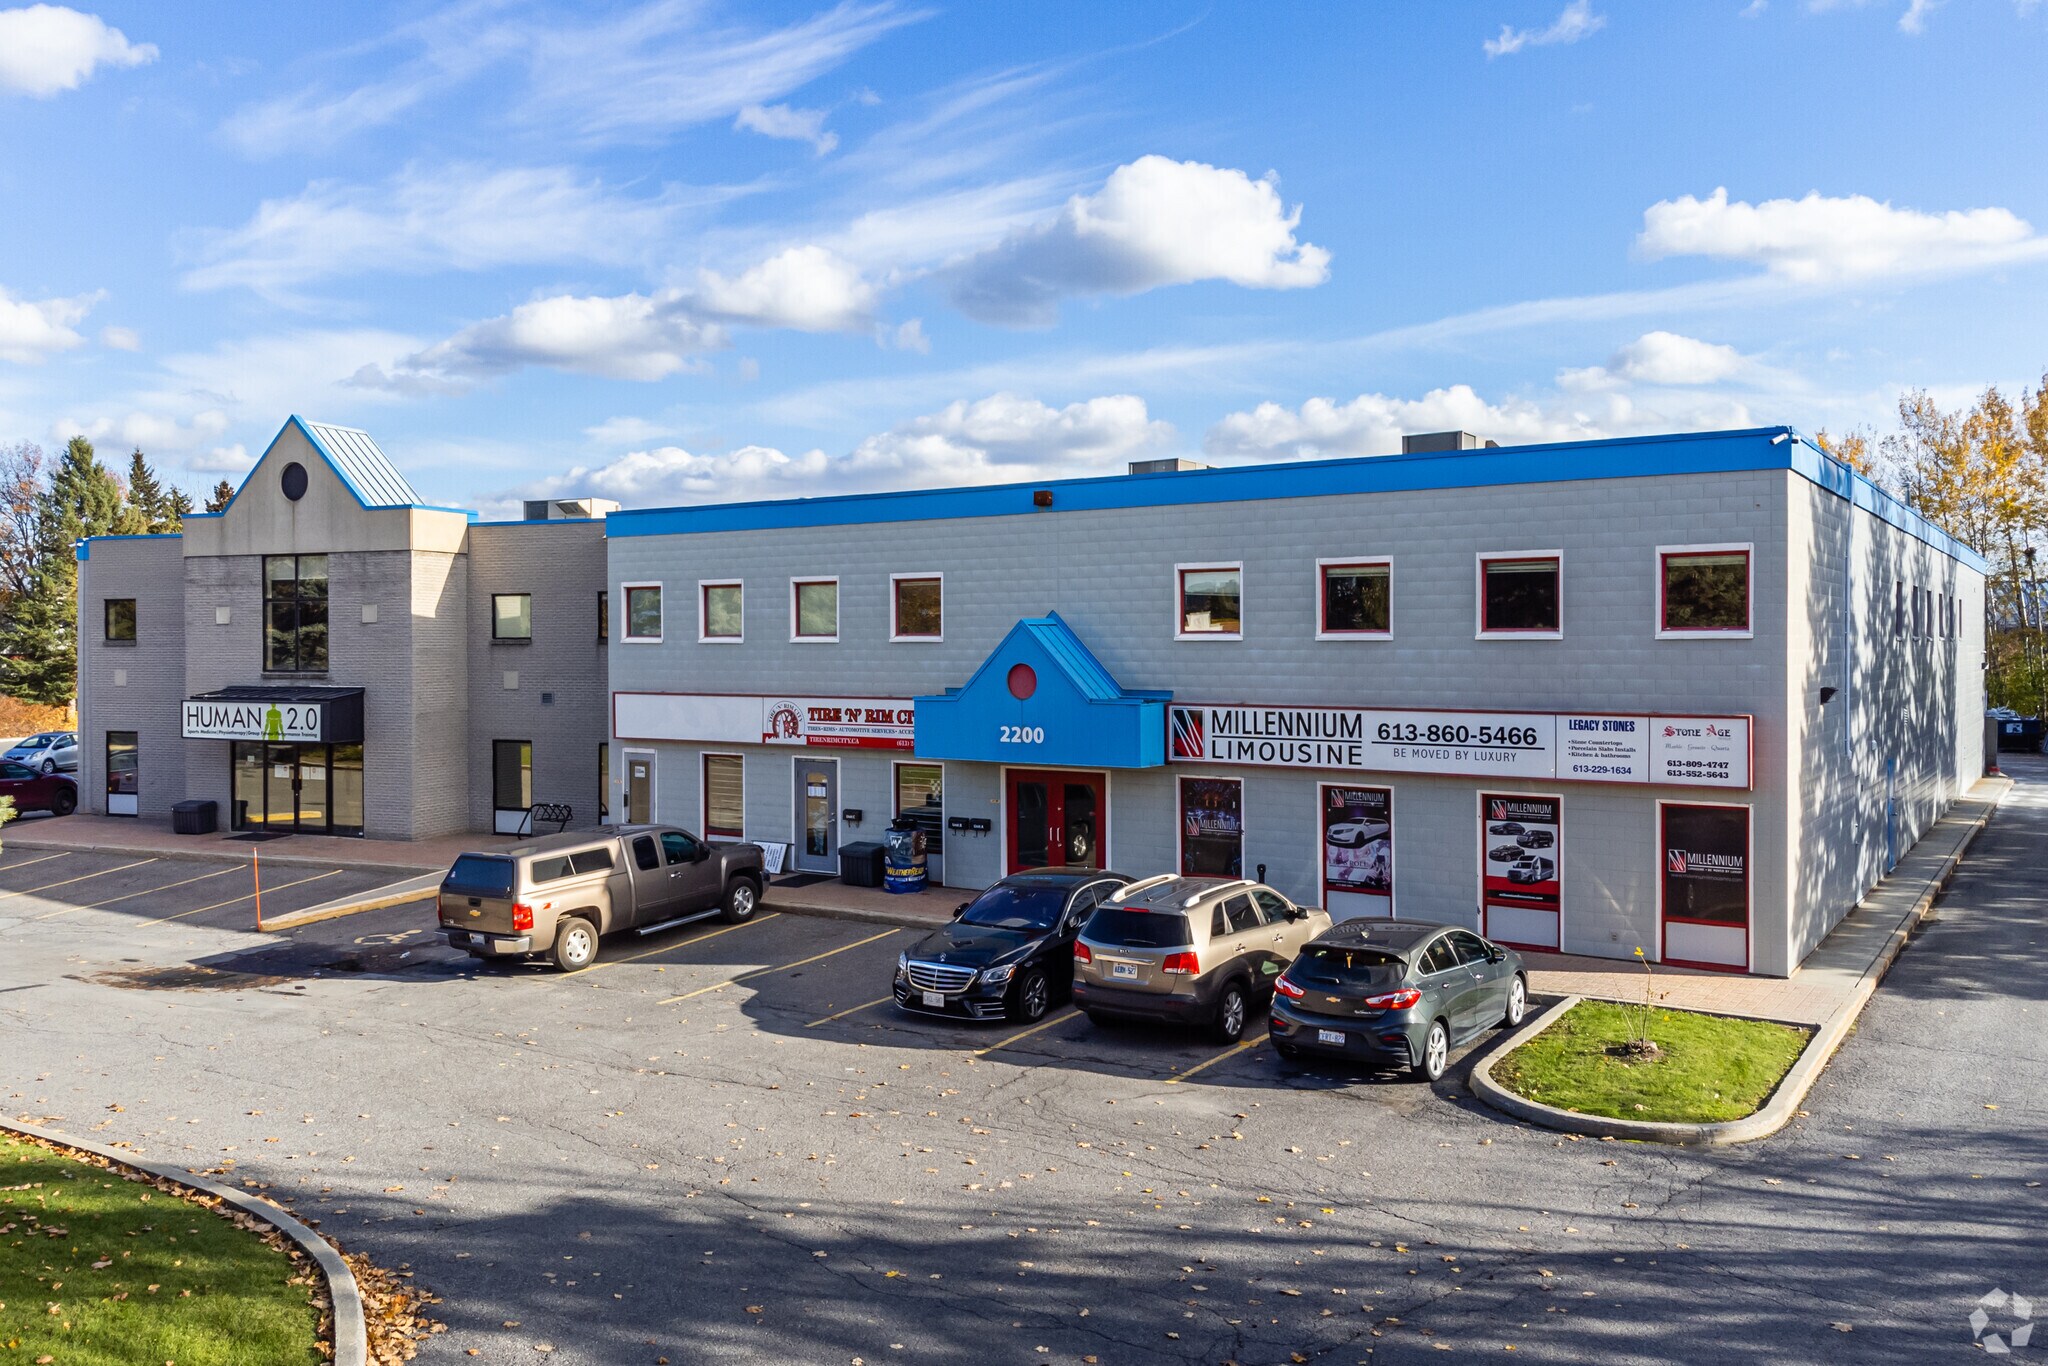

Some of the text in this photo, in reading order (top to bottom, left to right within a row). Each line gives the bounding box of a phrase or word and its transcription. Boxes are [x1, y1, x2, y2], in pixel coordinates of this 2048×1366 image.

[187, 705, 317, 730] HUMAN 2.0
[807, 707, 842, 722] TIRE
[864, 708, 894, 724] RIM
[897, 709, 914, 724] CI
[1211, 709, 1362, 738] MILLENNIUM
[1568, 719, 1635, 732] LEGACY STONES
[1000, 725, 1045, 744] 2200
[1377, 722, 1538, 746] 613-860-5466
[1211, 740, 1362, 765] LIMOUSINE
[1393, 747, 1517, 762] BE MOVED BY LUXURY
[1573, 764, 1632, 775] 613-229-1634
[1667, 759, 1729, 769] 613-809-4747
[1667, 769, 1729, 779] 613-552-5643
[1344, 791, 1385, 802] MILLENNIUM
[1507, 802, 1552, 814] MILLENNIUM
[1200, 819, 1241, 831] MILLENNIUM
[1687, 852, 1743, 867] MILLENNIUM
